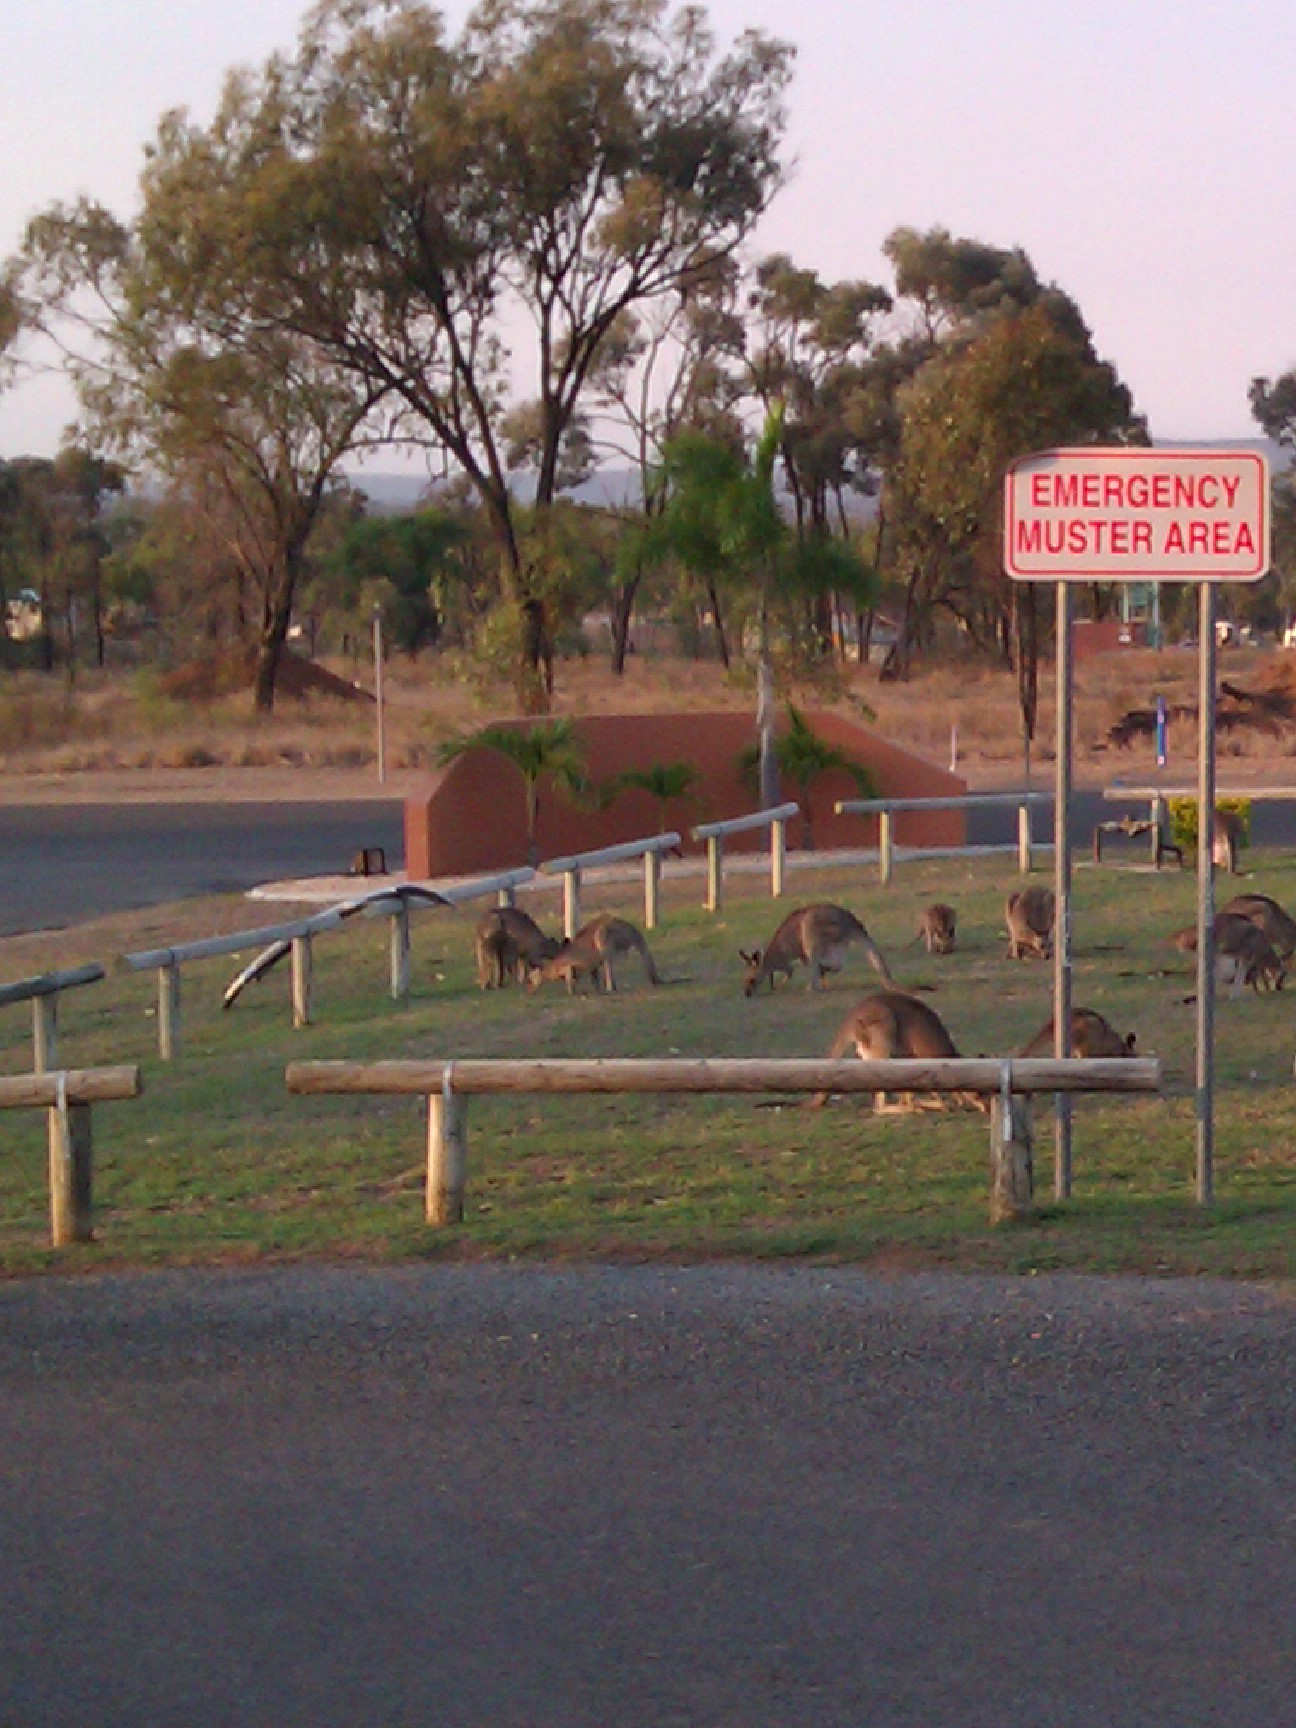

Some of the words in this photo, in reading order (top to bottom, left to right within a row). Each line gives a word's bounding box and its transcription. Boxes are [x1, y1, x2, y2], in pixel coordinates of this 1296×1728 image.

[1031, 474, 1240, 508] EMERGENCY
[1017, 519, 1153, 554] MUSTER
[1164, 521, 1255, 554] AREA
